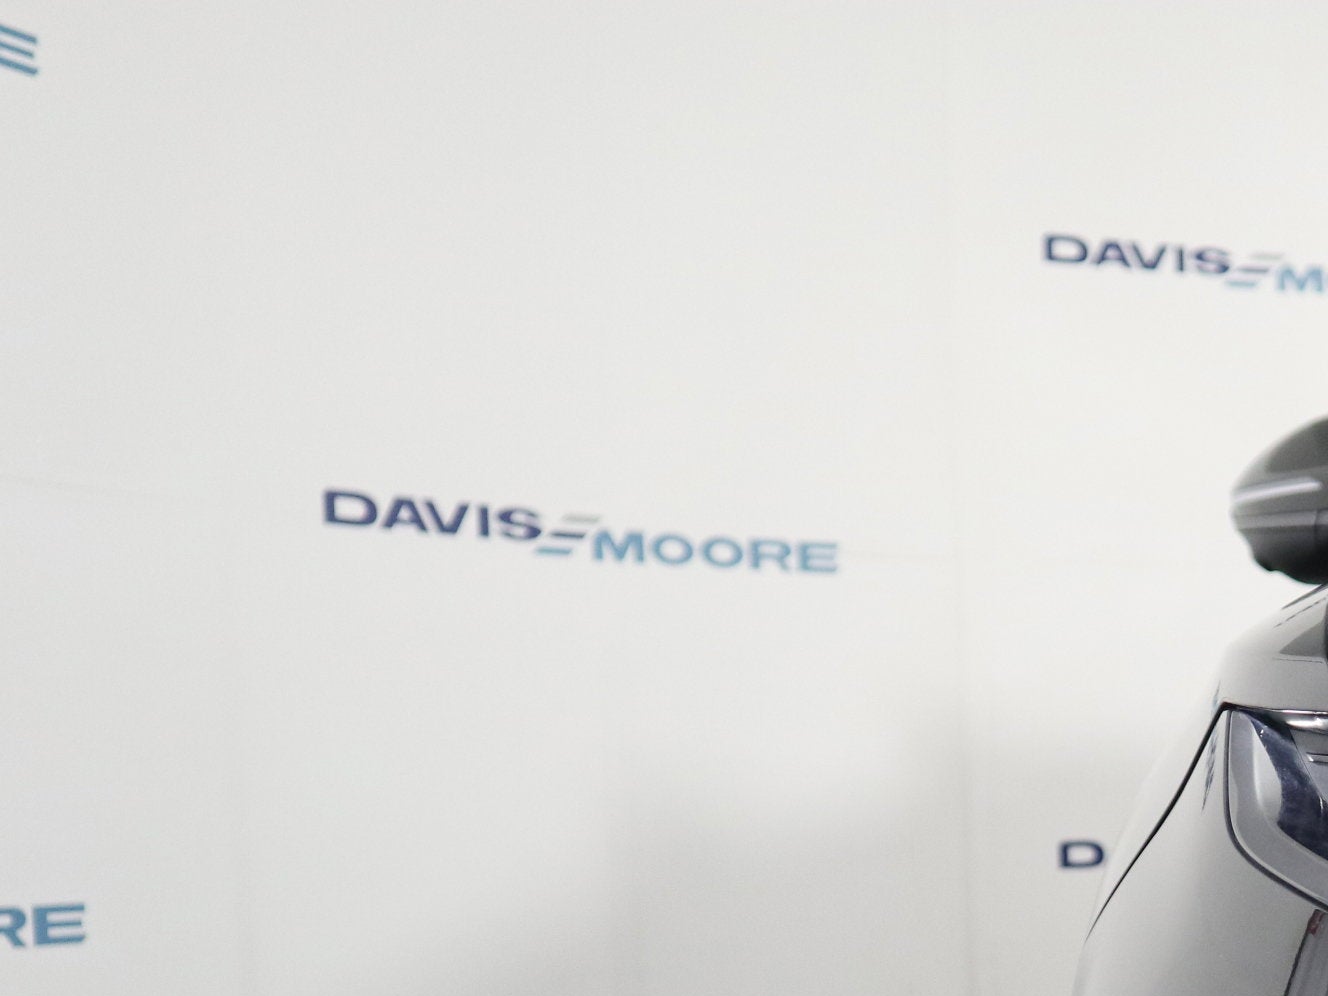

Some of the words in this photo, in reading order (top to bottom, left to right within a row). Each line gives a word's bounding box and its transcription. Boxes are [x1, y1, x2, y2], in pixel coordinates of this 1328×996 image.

[1042, 233, 1231, 276] DAVIS
[321, 488, 543, 542] DAVIS
[591, 529, 838, 574] MOORE
